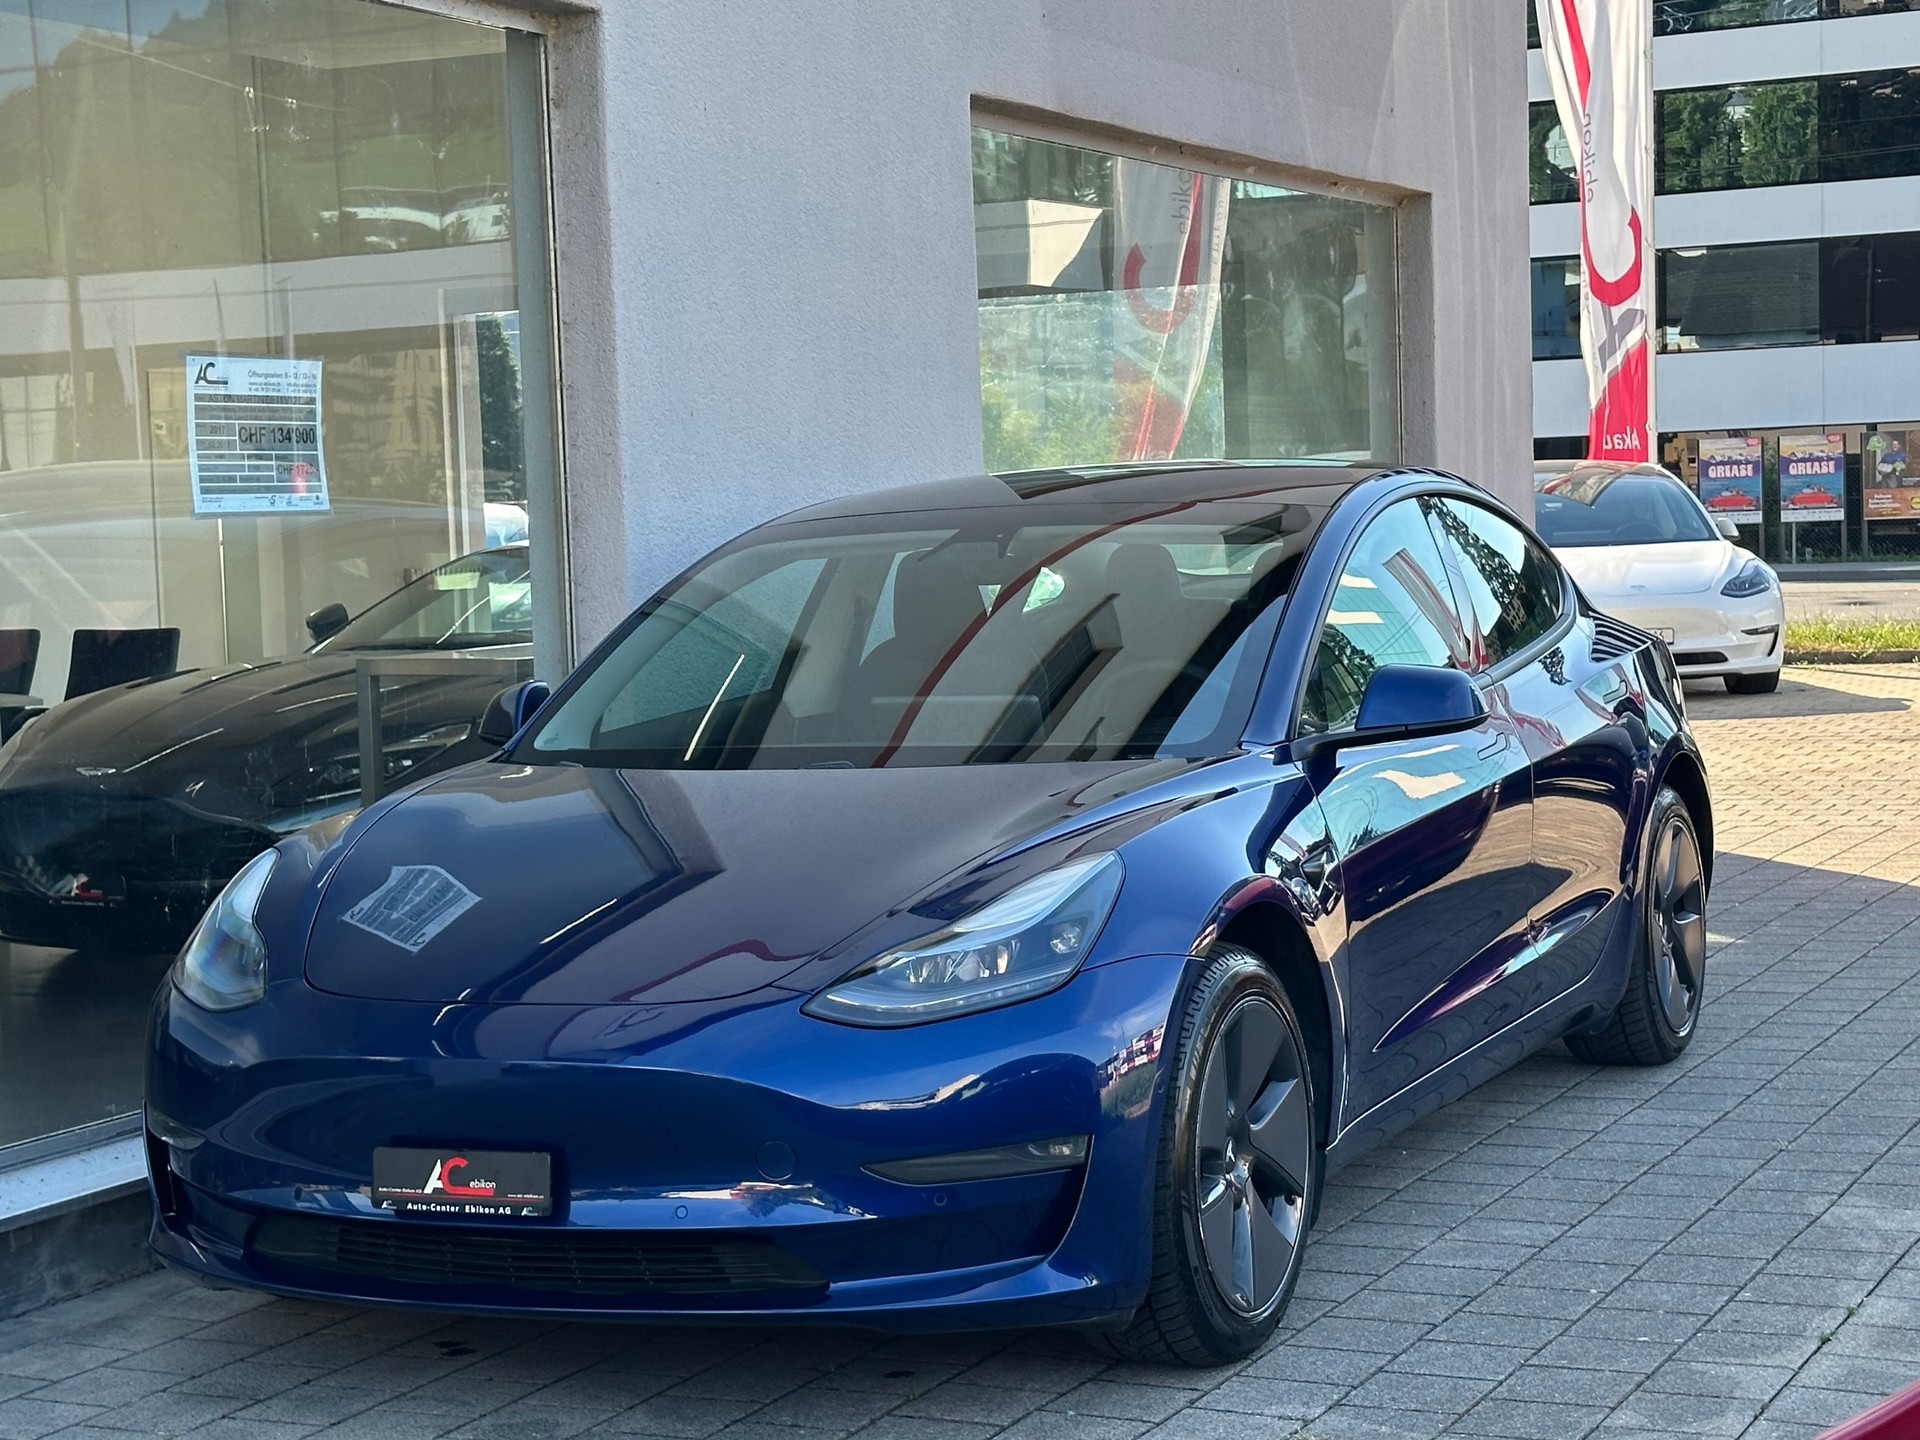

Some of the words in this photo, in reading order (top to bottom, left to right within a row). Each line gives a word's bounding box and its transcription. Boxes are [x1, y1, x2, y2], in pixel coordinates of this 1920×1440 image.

[209, 425, 226, 435] 2017
[239, 426, 266, 444] CHF
[277, 463, 294, 475] CHF
[1708, 463, 1754, 478] GREASE
[1788, 460, 1836, 475] GREASE
[469, 1178, 496, 1189] ebikon
[406, 1202, 460, 1213] Auto-Center
[464, 1204, 495, 1214] Ebikon
[498, 1206, 512, 1215] AG
